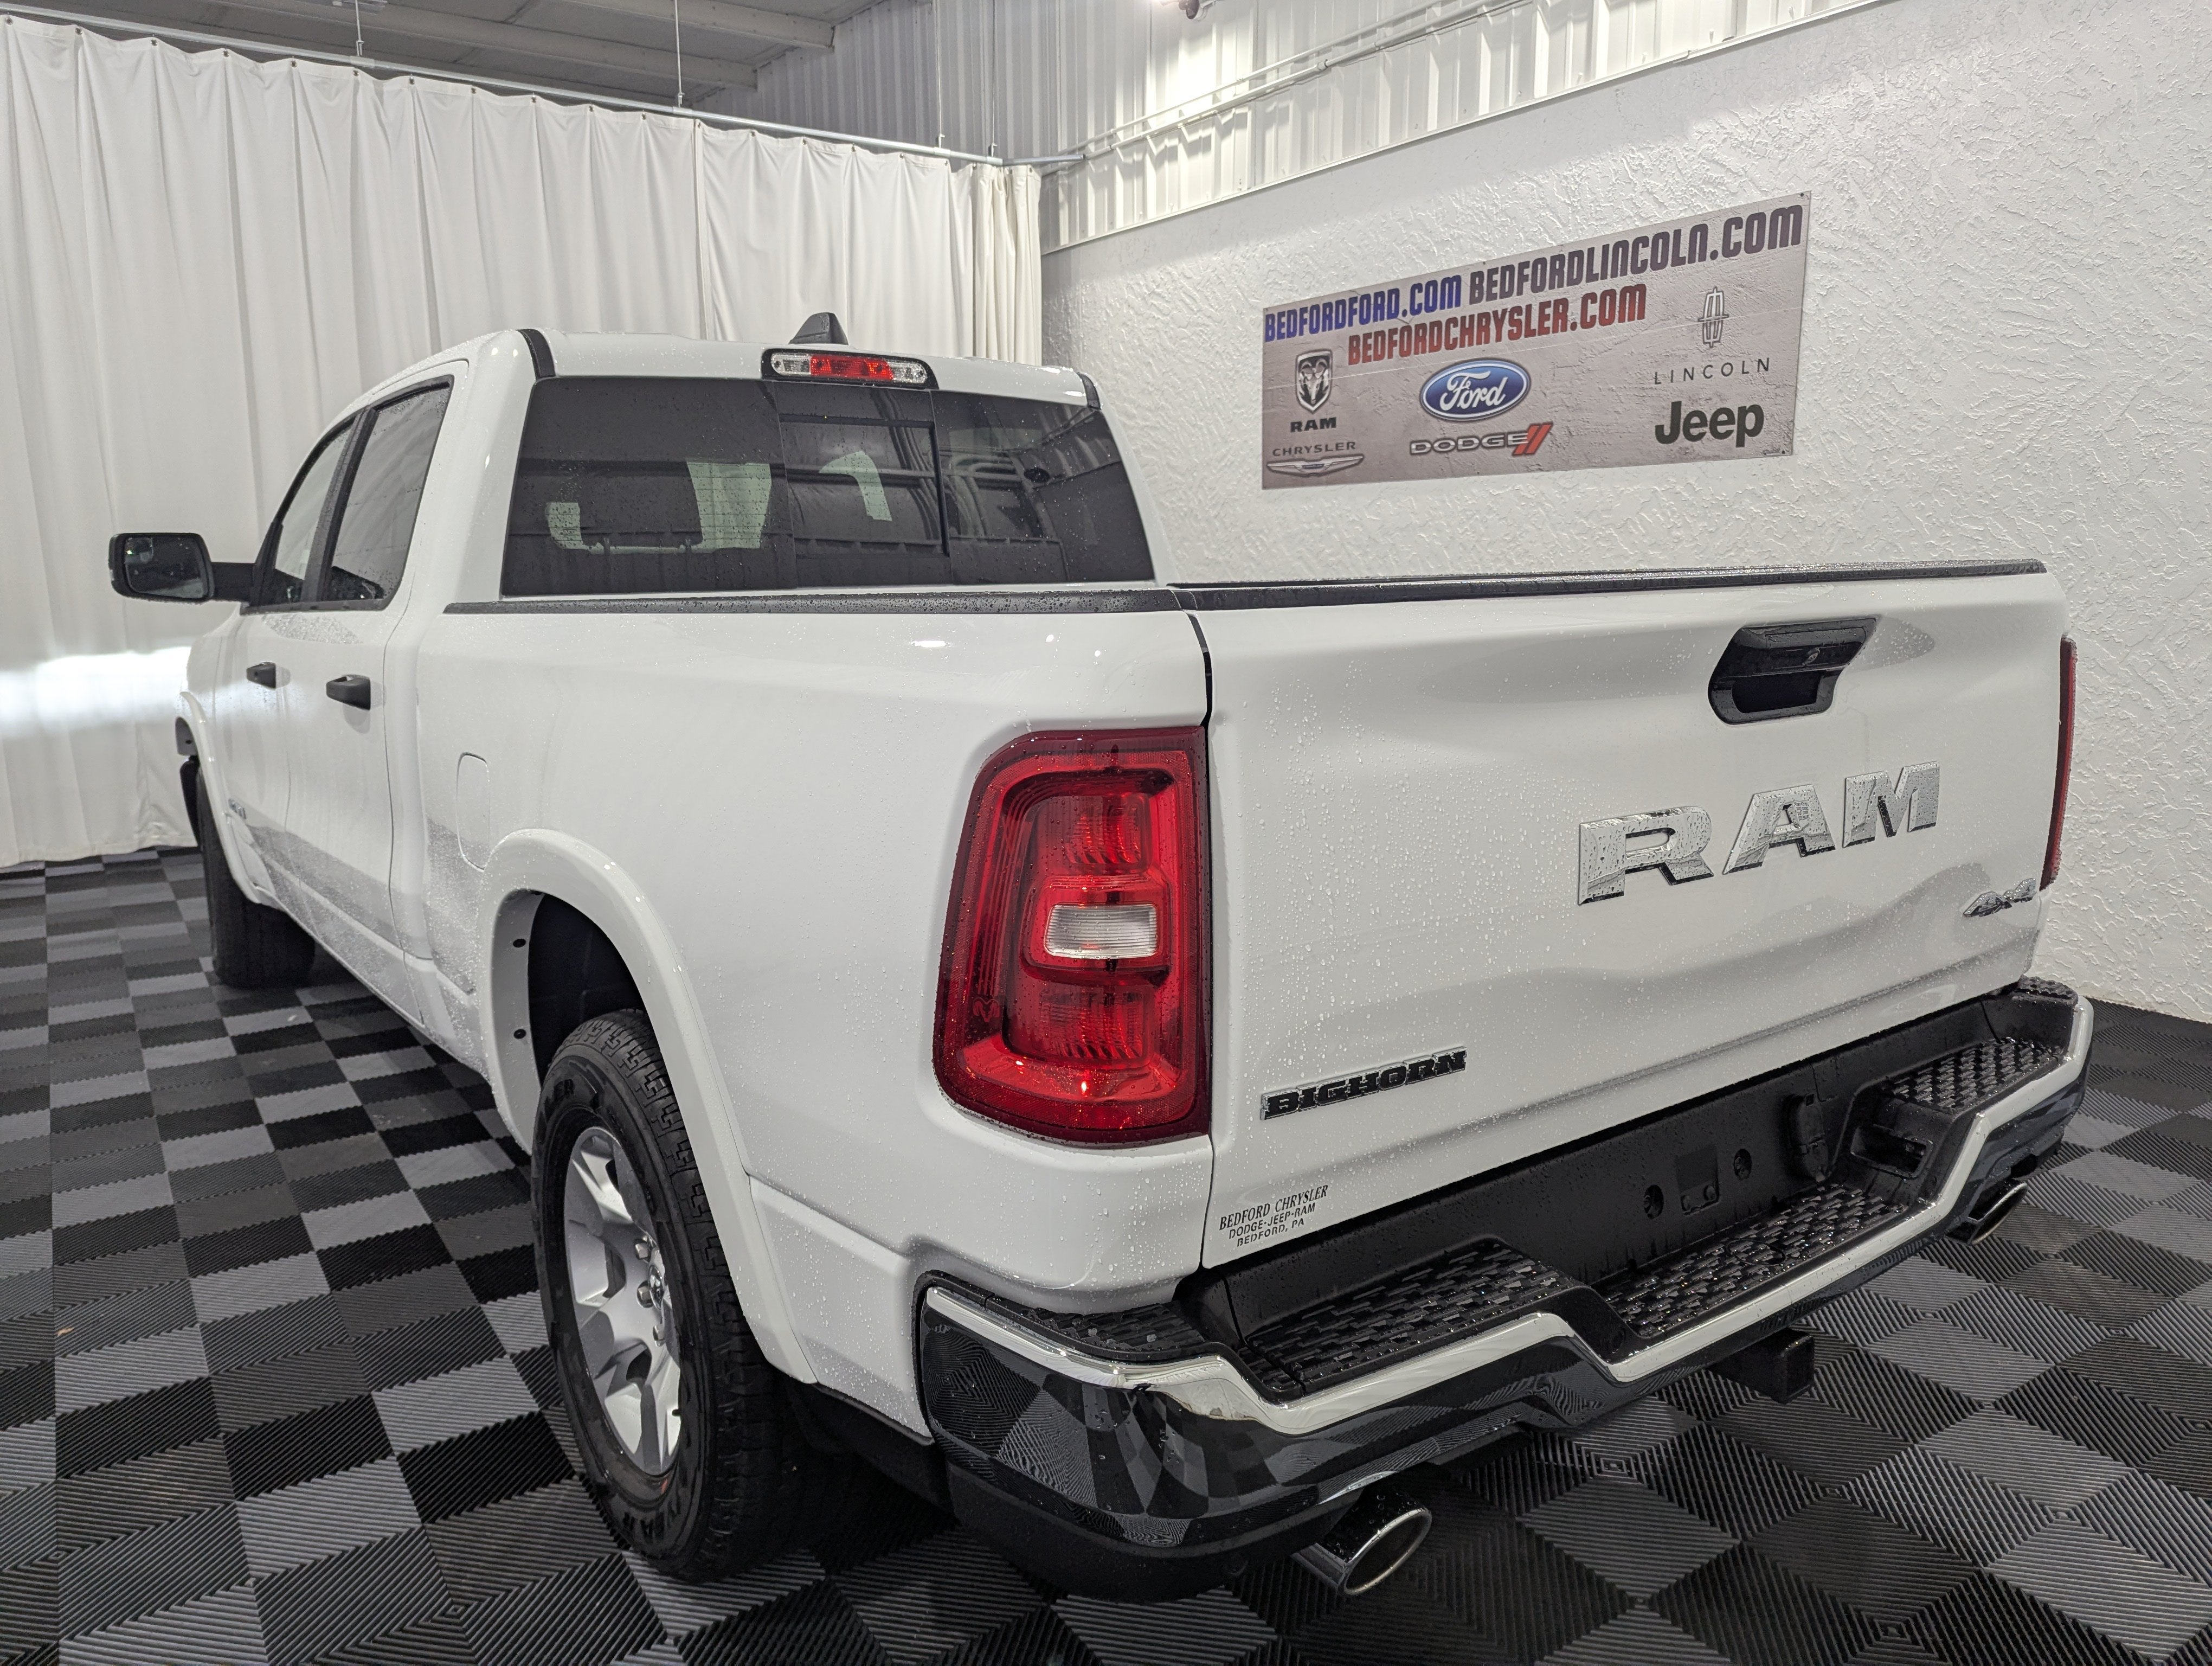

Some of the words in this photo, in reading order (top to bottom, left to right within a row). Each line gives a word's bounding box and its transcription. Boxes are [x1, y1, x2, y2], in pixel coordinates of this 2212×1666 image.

[1265, 275, 1461, 342] BEDFORDFORD.COM
[1469, 204, 1803, 304] BEDFORDLINCOLN.COM
[1348, 283, 1646, 366] BEDFORDCHRYSLER.COM
[1439, 371, 1508, 411] Ford
[1655, 357, 1770, 385] LINCOLN
[1290, 417, 1337, 433] RAM
[1410, 430, 1529, 456] DODGE
[1655, 401, 1764, 448] Jeep
[1272, 441, 1356, 457] CHRYSLER
[1578, 760, 1940, 905] RAM
[1219, 1203, 1270, 1231] BEDFORD
[1275, 1185, 1328, 1213] CHRYSLER
[1237, 1224, 1288, 1247] BEDFORD,
[1291, 1218, 1304, 1228] PA
